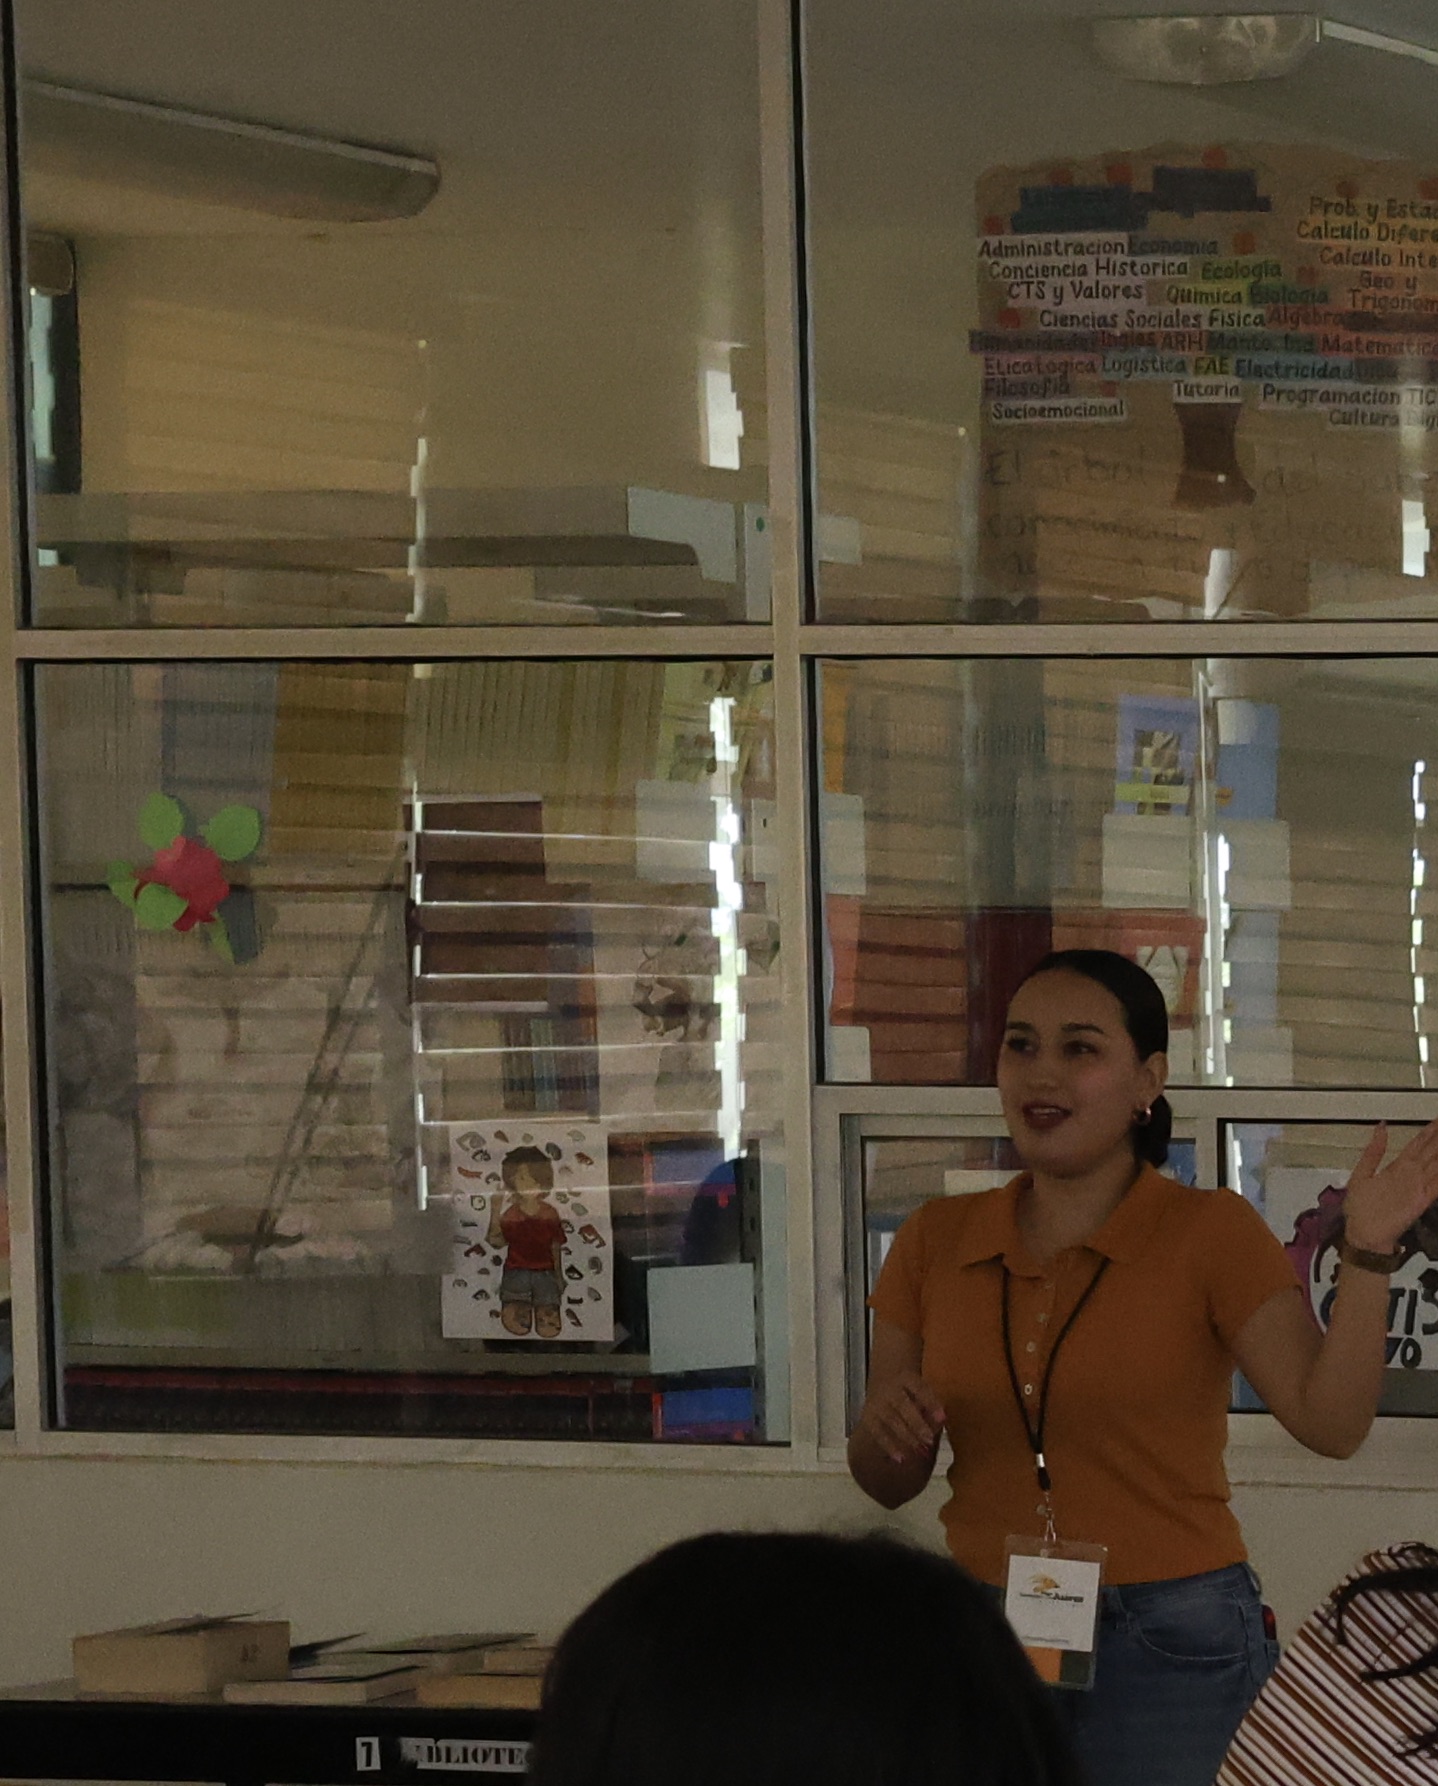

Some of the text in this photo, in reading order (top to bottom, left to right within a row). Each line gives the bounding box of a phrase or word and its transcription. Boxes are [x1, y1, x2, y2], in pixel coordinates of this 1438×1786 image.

[979, 238, 1125, 258] Administracion
[988, 261, 1089, 280] Conciencia
[1094, 257, 1188, 277] Historica
[1007, 280, 1047, 300] CTS
[1052, 286, 1065, 305] y
[1069, 280, 1143, 301] Valores
[1039, 310, 1119, 330] Ciencias
[1124, 308, 1202, 329] Sociales
[1208, 309, 1265, 328] Fisica
[991, 401, 1125, 421] Socioemocional
